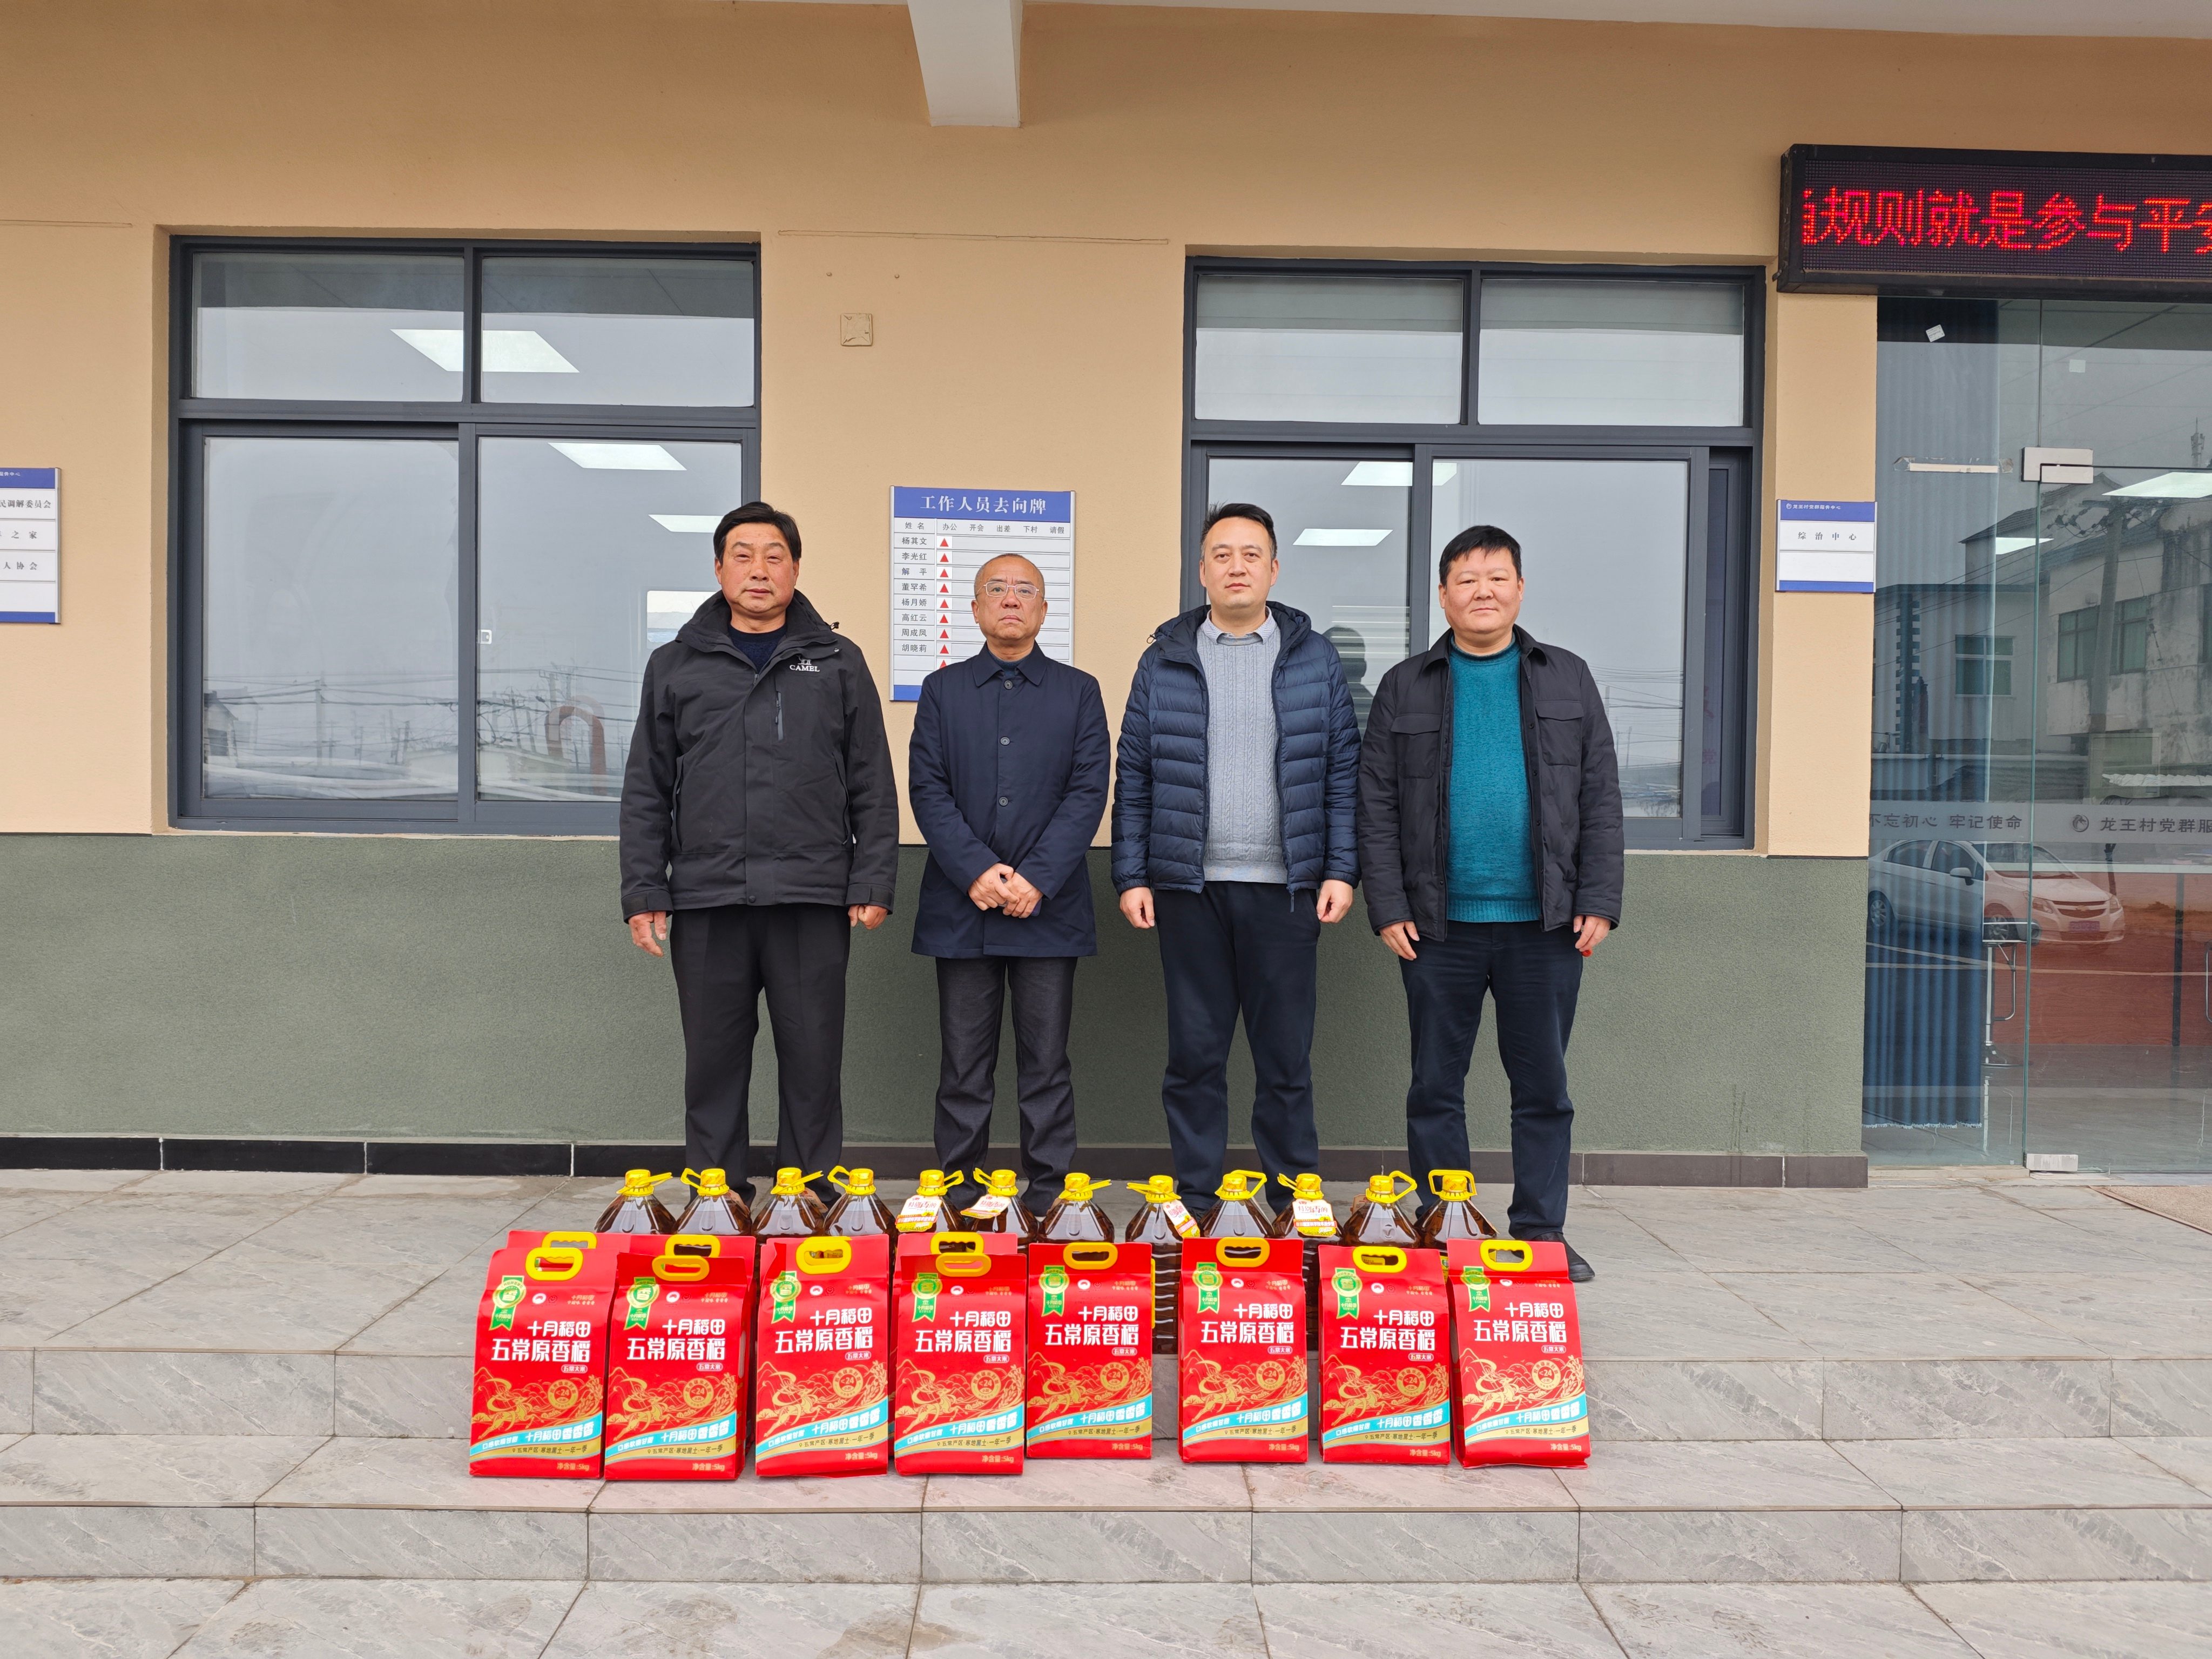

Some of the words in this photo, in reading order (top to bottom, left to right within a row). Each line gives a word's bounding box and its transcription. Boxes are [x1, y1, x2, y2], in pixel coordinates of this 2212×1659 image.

[1802, 186, 2212, 253] 规则就是参与平
[920, 495, 1046, 514] 工作人员去向牌
[0, 530, 38, 539] 之家
[902, 536, 927, 546] 杨其文
[1798, 532, 1857, 540] 综治中心
[902, 551, 927, 561] 李光红
[902, 583, 927, 592] 董罕希
[902, 598, 927, 607] 杨月娇
[902, 613, 927, 622] 高红云
[901, 629, 927, 637] 周成凤
[902, 644, 927, 652] 胡晓莉
[1870, 813, 1938, 828] 不忘初心
[1950, 814, 2022, 830] 牢记使命
[2100, 817, 2212, 833] 龙王村党群服
[810, 1307, 872, 1326] 十月稻田
[949, 1311, 1011, 1327] 十月稻田
[1078, 1306, 1138, 1322] 十月稻田
[1233, 1304, 1293, 1320] 十月稻田
[1374, 1310, 1434, 1326] 十月稻田
[1505, 1303, 1564, 1318] 十月稻田
[527, 1321, 591, 1338] 十月稻田
[663, 1319, 725, 1336] 十月稻田
[1045, 1324, 1139, 1346] 五常原香稻
[1201, 1321, 1294, 1344] 五常原香稻
[1474, 1320, 1566, 1343] 五常原香稻
[775, 1326, 873, 1354] 五常原香稻
[915, 1330, 1011, 1353] 五常原香稻
[1340, 1327, 1435, 1350] 五常原香稻
[491, 1339, 590, 1362] 五常原香稻
[627, 1338, 725, 1360] 五常原香稻
[812, 1407, 880, 1434] 十月稻田香香香
[1081, 1402, 1145, 1424] 十月稻田香香香
[1378, 1408, 1443, 1428] 十月稻田香香香
[525, 1421, 594, 1442] 十月稻田香香香
[661, 1420, 730, 1442] 十月稻田香香香
[950, 1412, 1017, 1434] 十月稻田香香香
